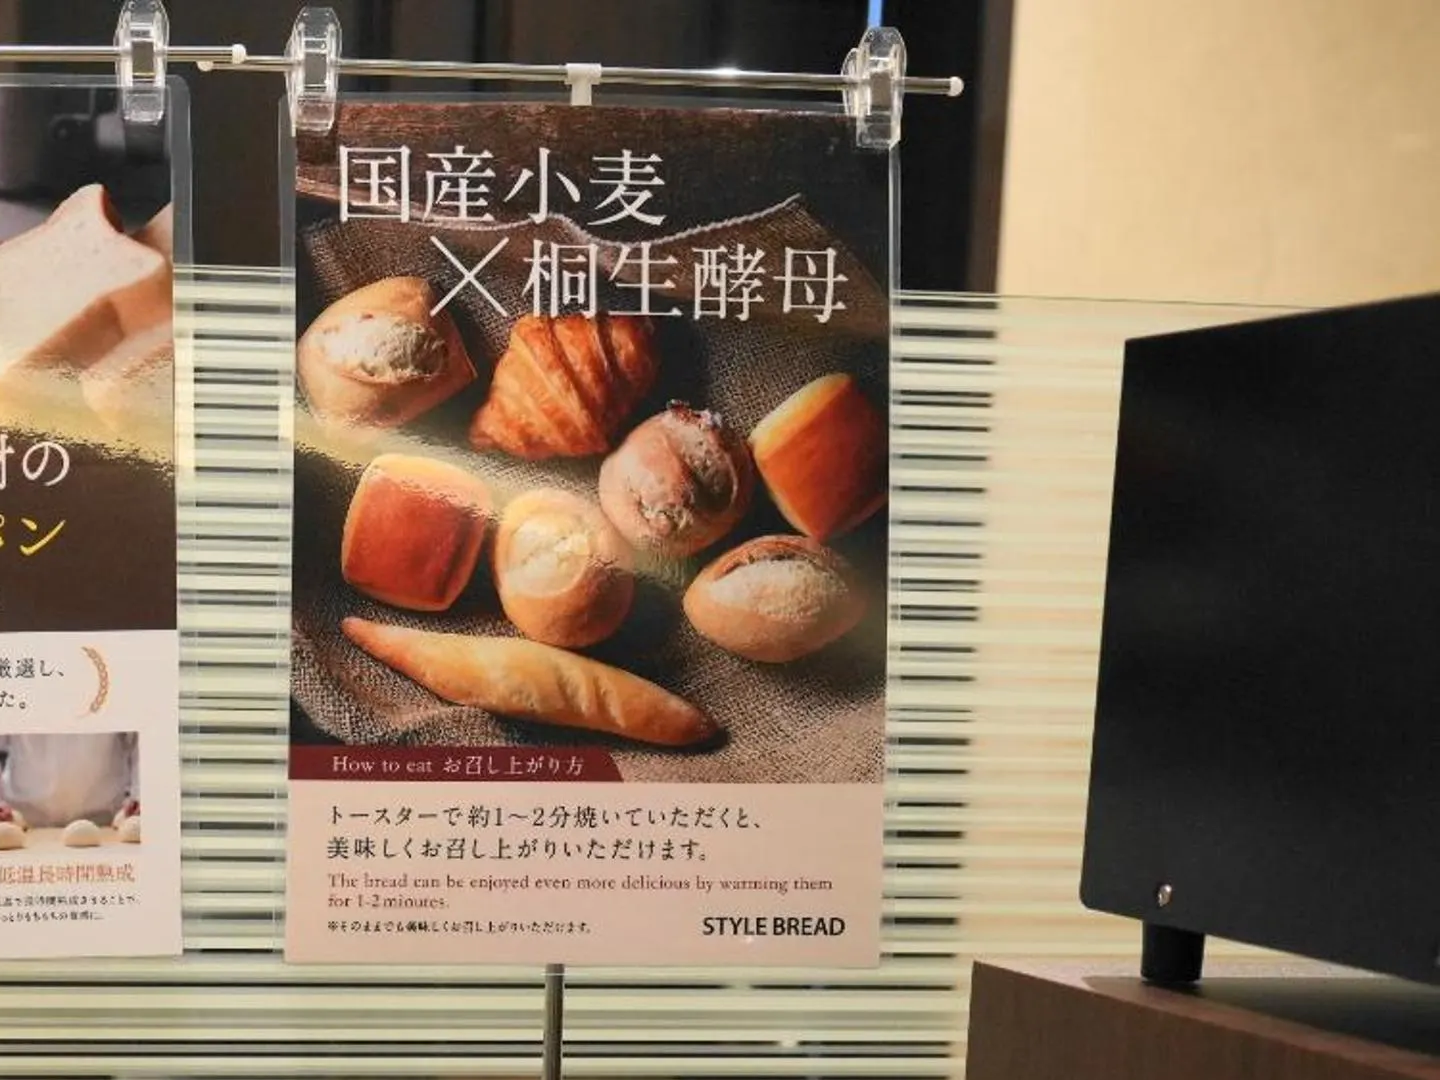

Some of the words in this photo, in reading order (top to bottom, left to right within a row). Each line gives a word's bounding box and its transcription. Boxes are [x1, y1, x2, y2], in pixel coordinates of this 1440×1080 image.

[339, 144, 666, 226] 国産小麦
[332, 756, 375, 773] How
[382, 758, 400, 773] to
[406, 760, 433, 773] eat
[442, 755, 585, 776] お召し上がり方
[326, 837, 708, 862] 美味しくお召し上がりいただけます。
[329, 873, 359, 889] The
[364, 873, 408, 889] bread
[414, 877, 441, 889] can
[446, 874, 465, 889] be
[470, 873, 530, 893] enjoyed
[535, 877, 572, 890] even
[577, 877, 616, 890] more
[621, 874, 691, 890] delicious
[696, 875, 713, 894] by
[718, 876, 789, 896] warming
[794, 877, 833, 891] them
[328, 892, 350, 908] for
[702, 916, 768, 936] STYLE
[772, 916, 846, 936] BREAD
